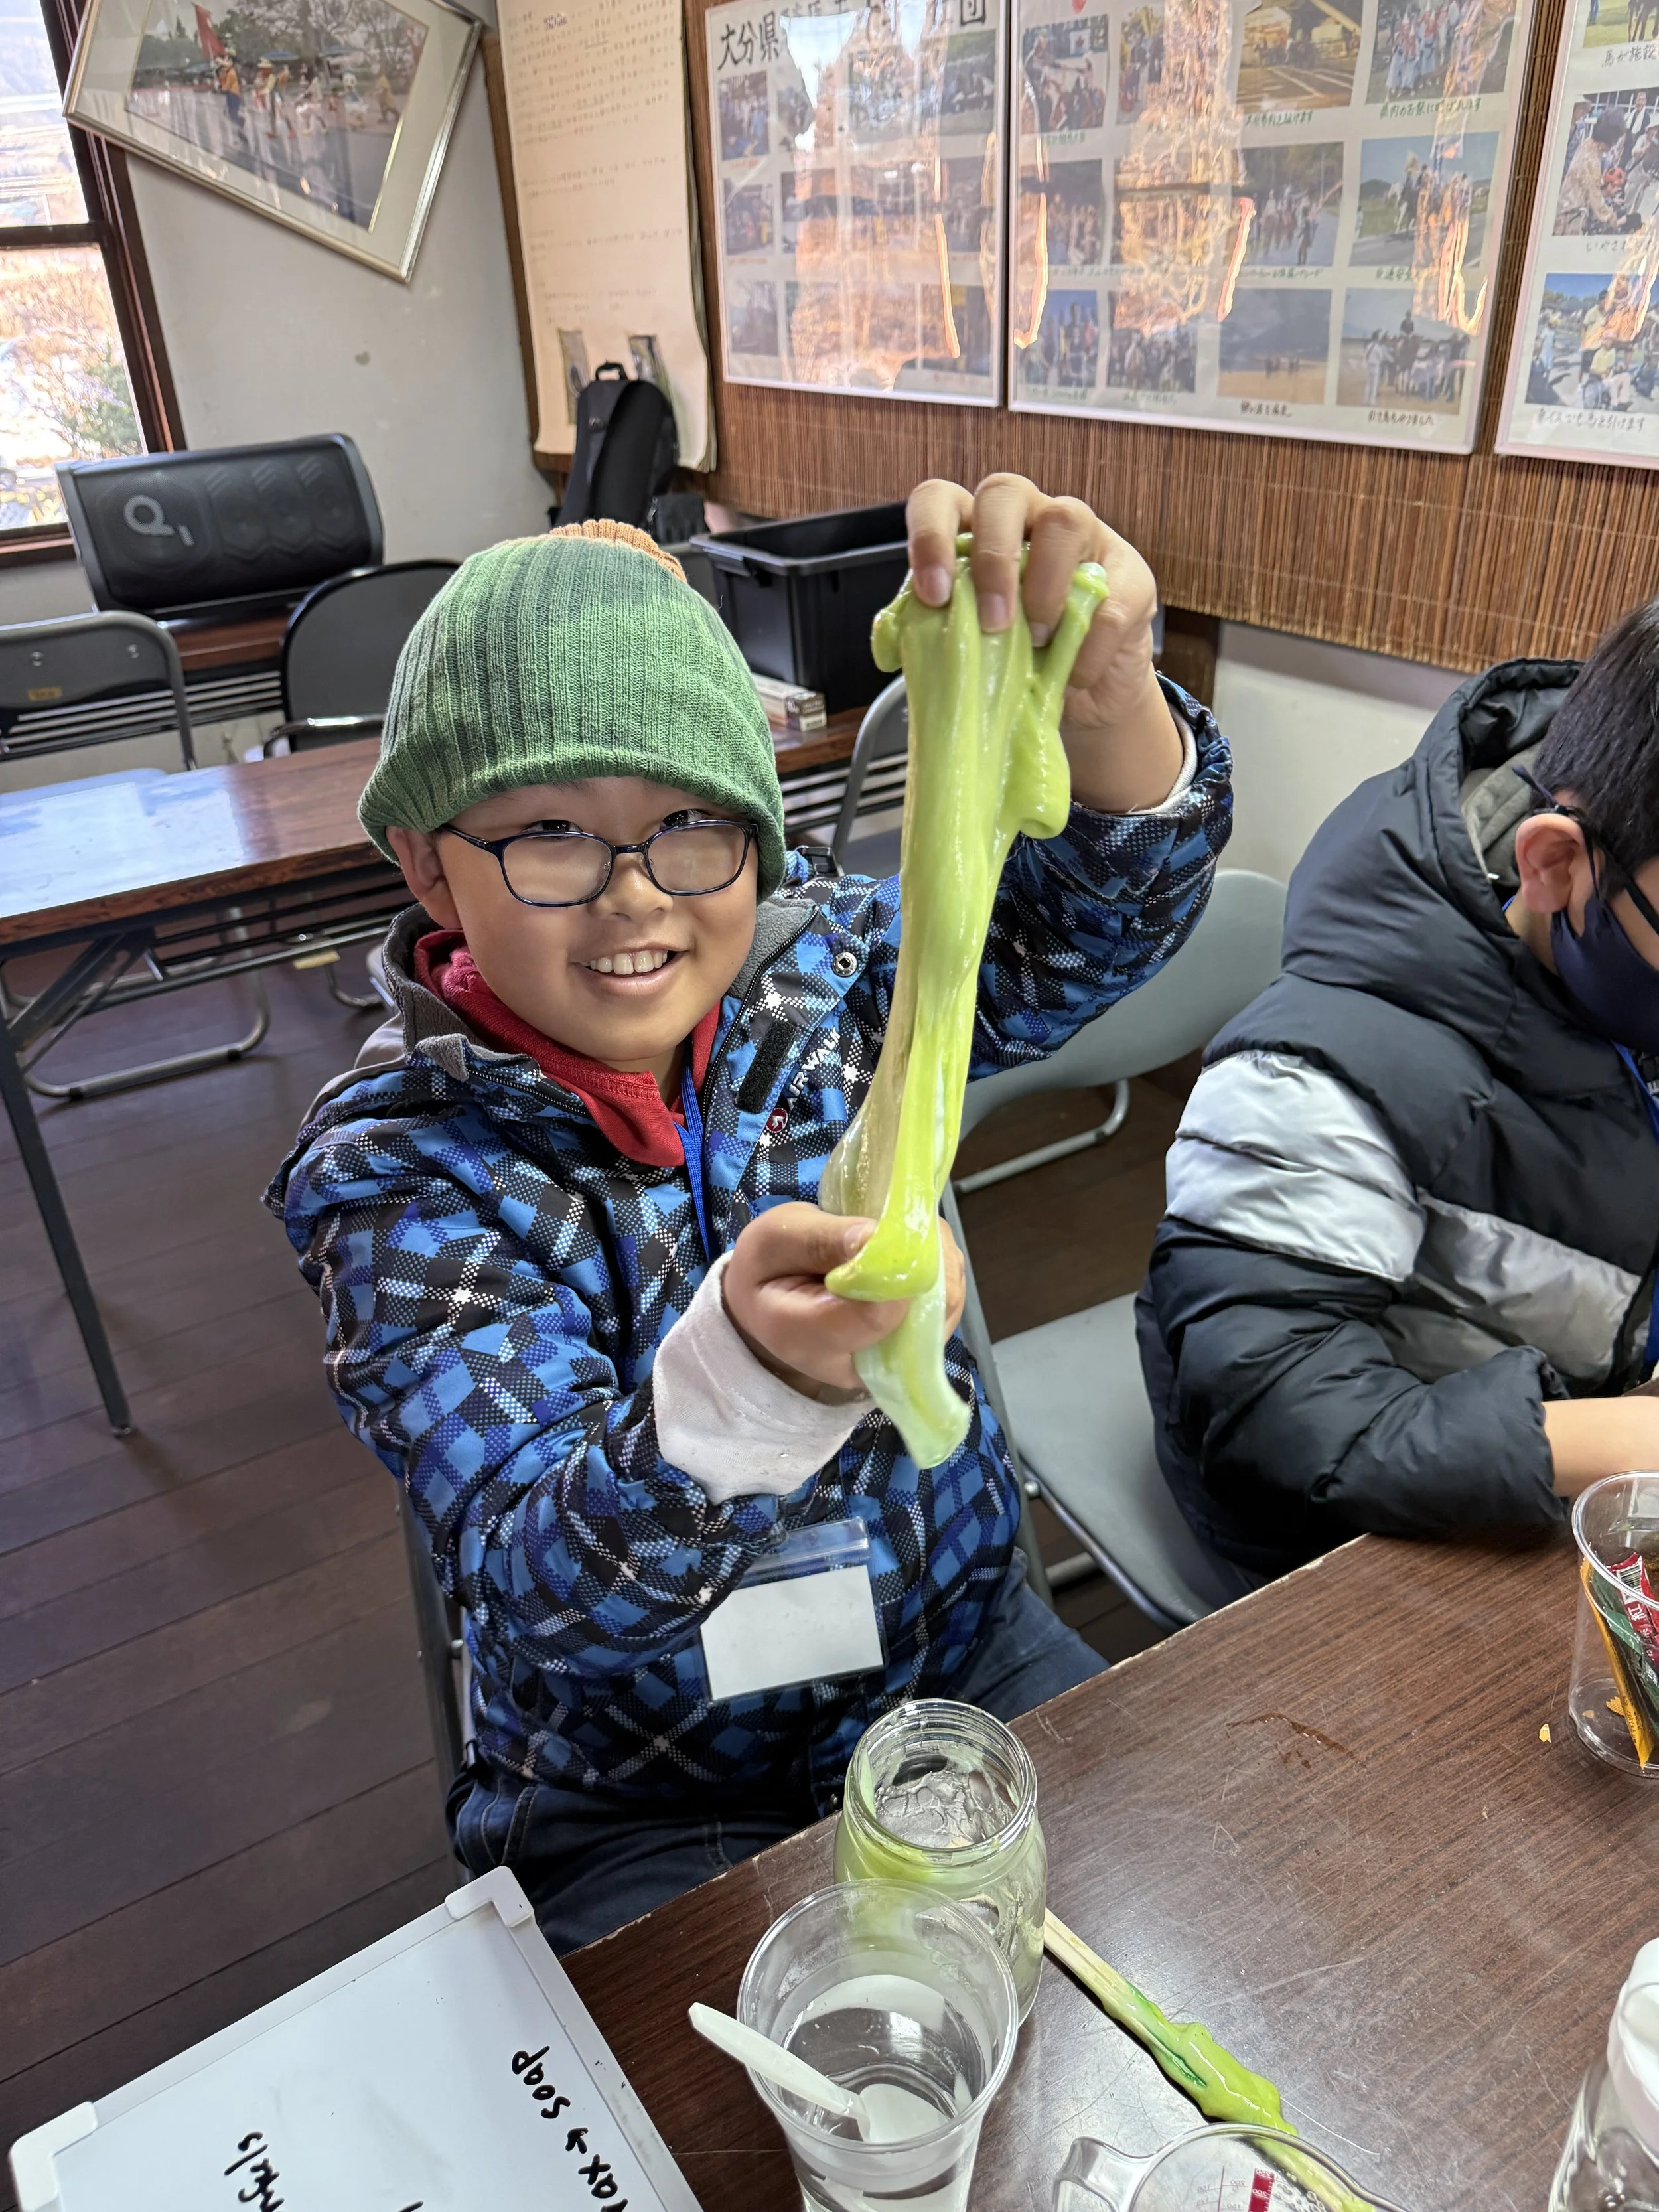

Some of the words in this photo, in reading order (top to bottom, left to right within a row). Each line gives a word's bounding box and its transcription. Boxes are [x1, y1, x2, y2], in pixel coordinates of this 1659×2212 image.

[717, 11, 780, 70] 大分県
[787, 1027, 841, 1111] AIRWALK
[512, 2045, 571, 2119] soap
